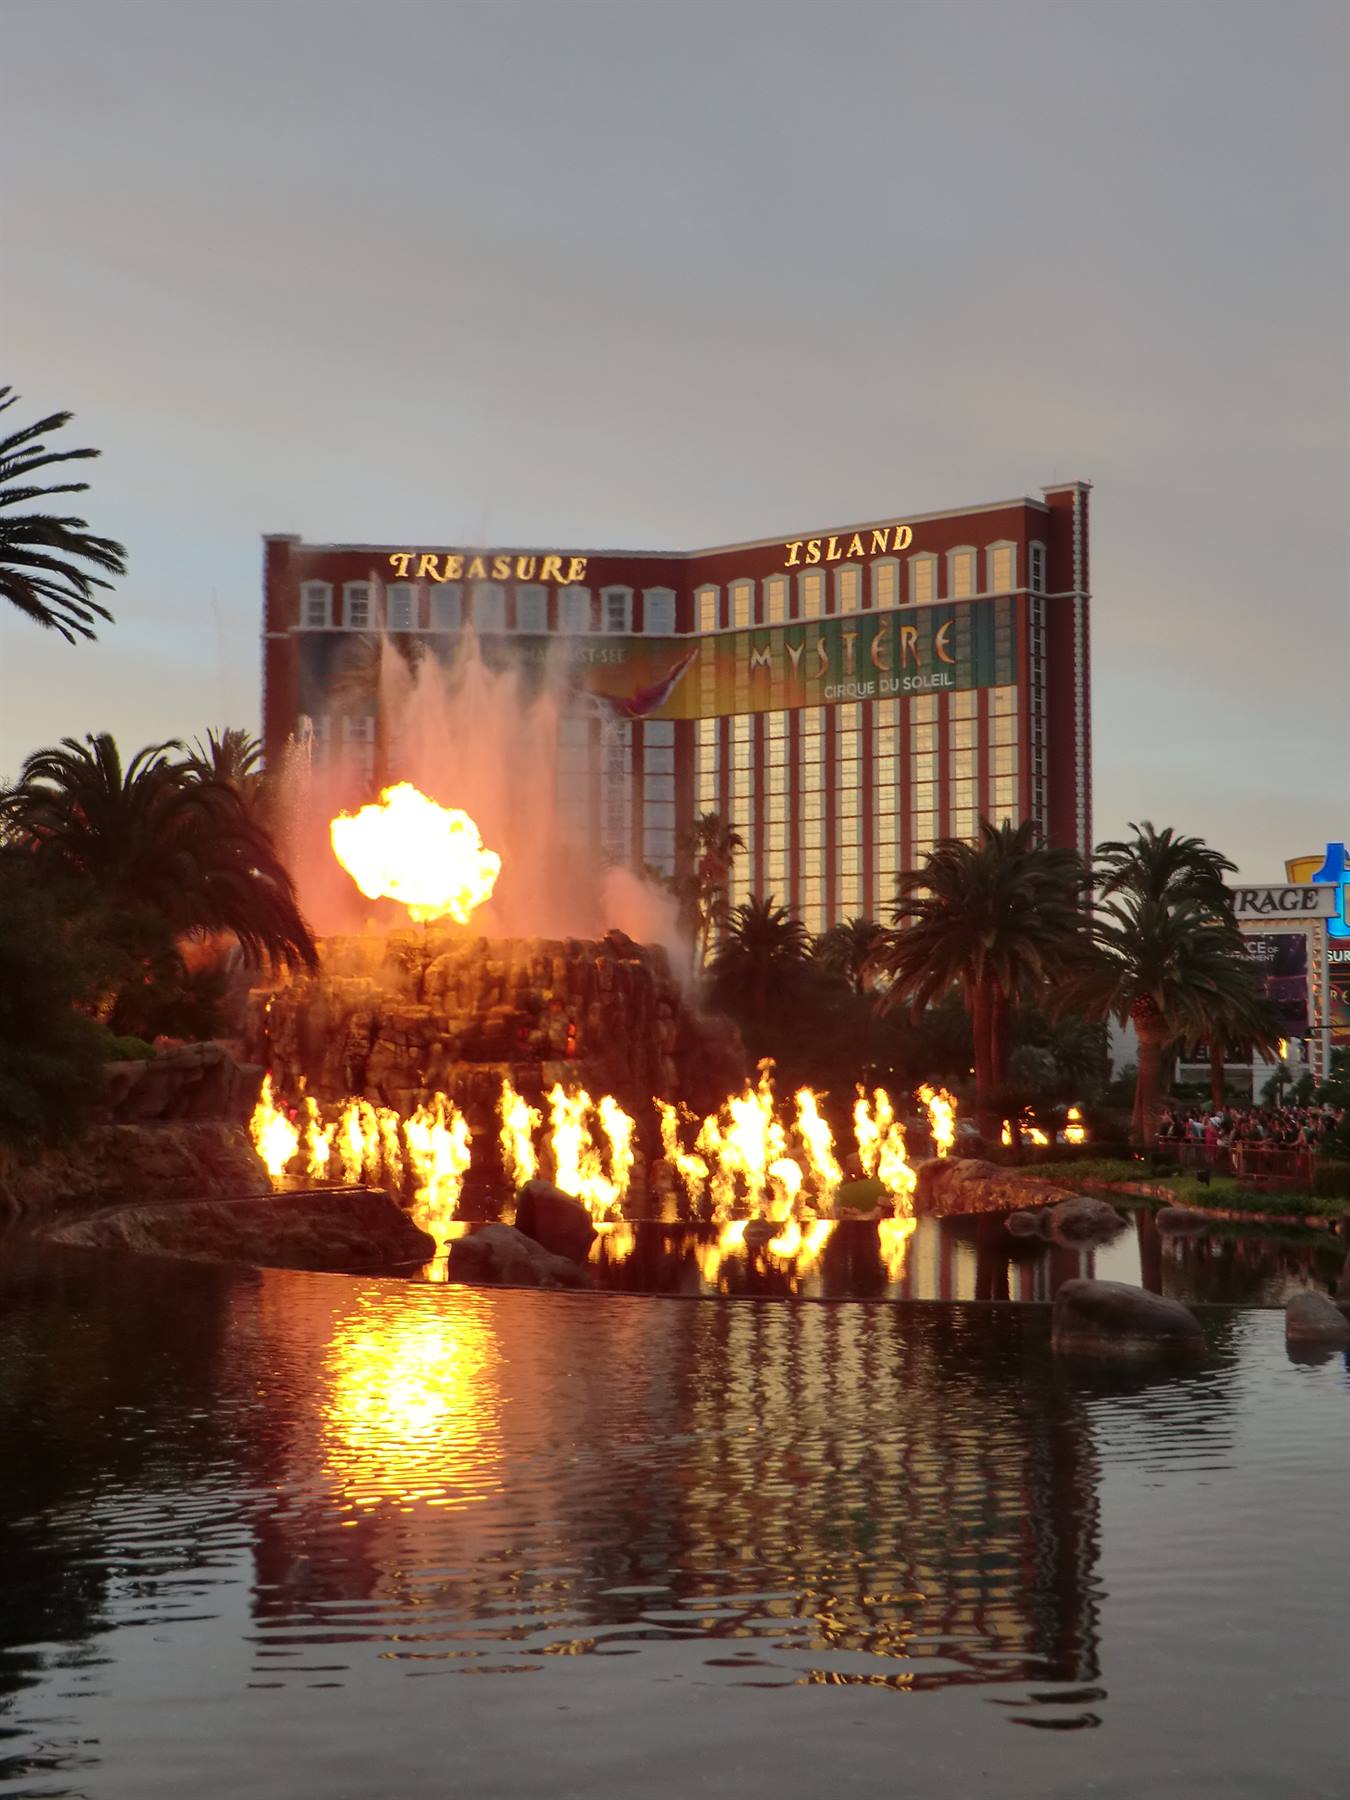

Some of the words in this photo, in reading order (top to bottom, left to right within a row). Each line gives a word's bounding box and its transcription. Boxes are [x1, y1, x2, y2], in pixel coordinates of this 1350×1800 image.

[784, 525, 913, 567] ISLAND
[389, 552, 588, 584] TREASURE
[823, 681, 876, 699] CIRQUE
[879, 678, 900, 692] DU
[902, 673, 955, 690] SOLEIL
[1230, 888, 1319, 914] IRAGE
